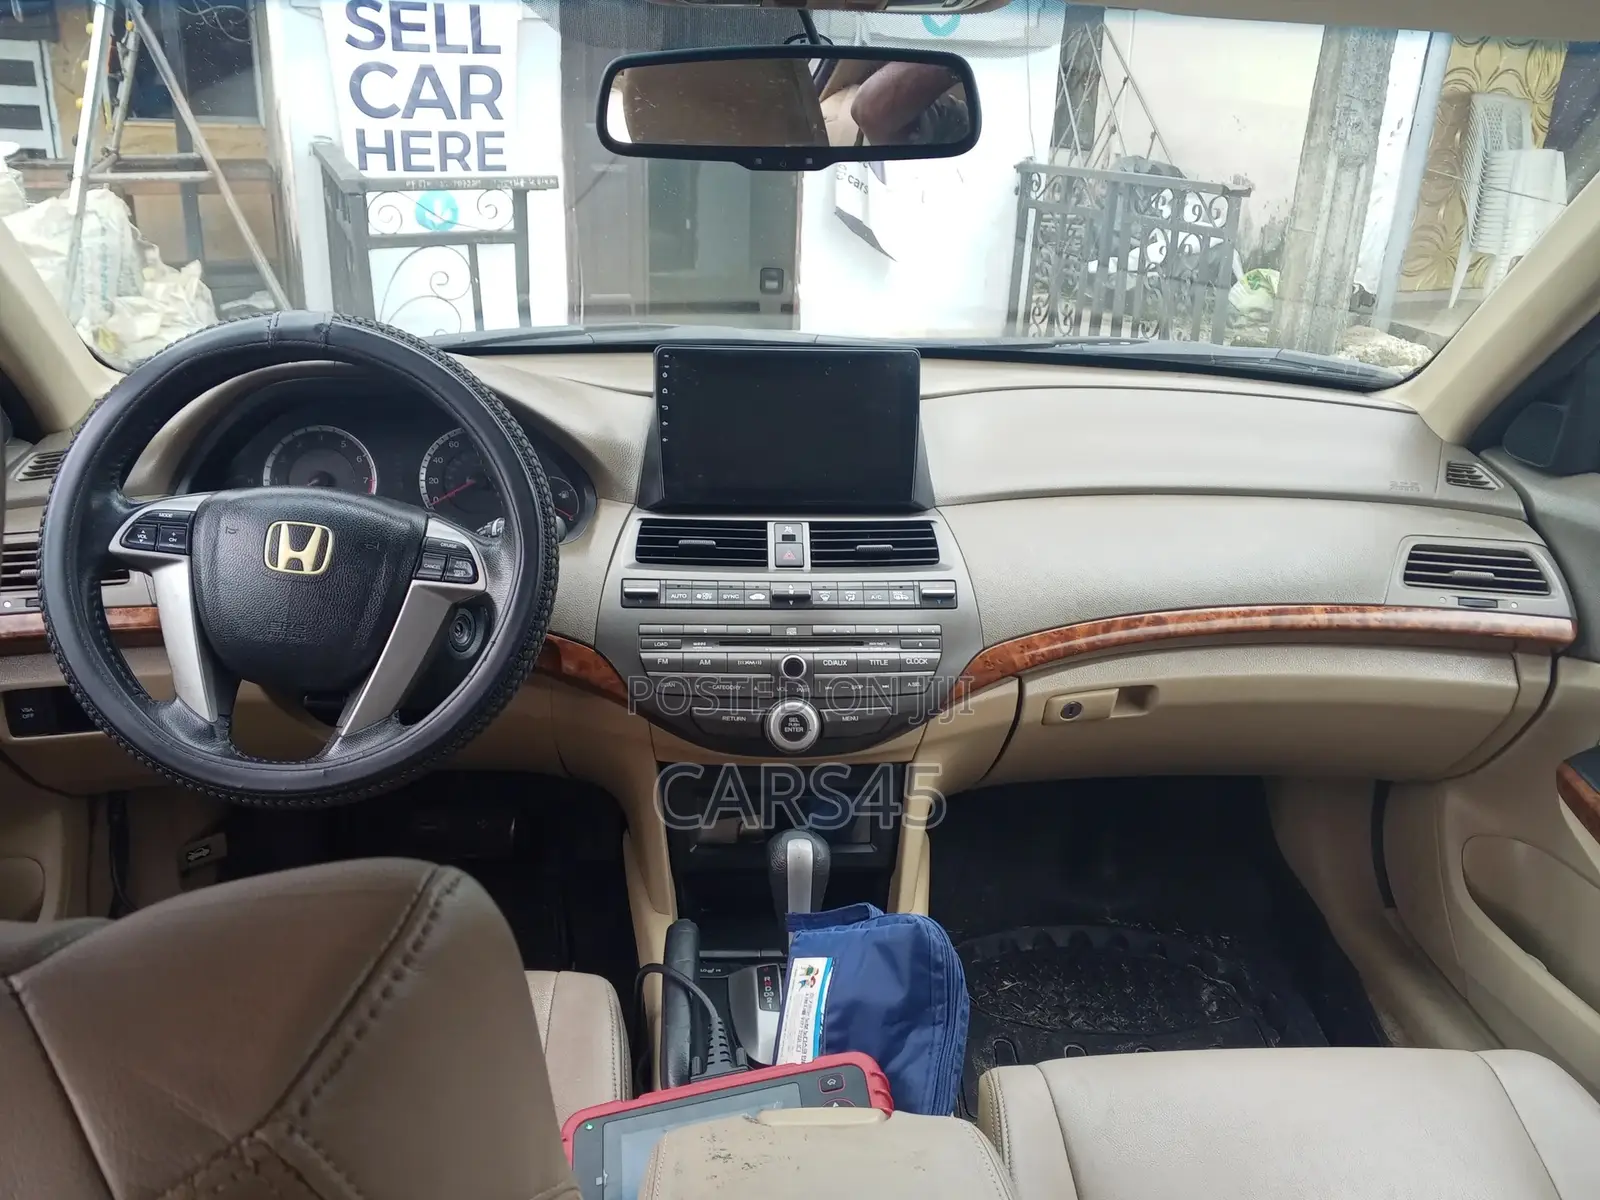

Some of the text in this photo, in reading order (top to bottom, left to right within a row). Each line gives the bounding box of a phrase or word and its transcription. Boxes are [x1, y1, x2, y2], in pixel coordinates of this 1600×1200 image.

[345, 0, 502, 54] SELL
[349, 61, 504, 120] CAR
[355, 128, 507, 172] HERE
[847, 174, 869, 194] cars
[340, 440, 347, 448] 5
[356, 455, 363, 463] 6
[362, 476, 369, 484] 7
[428, 477, 439, 485] 20
[822, 659, 848, 667] CD/AUX
